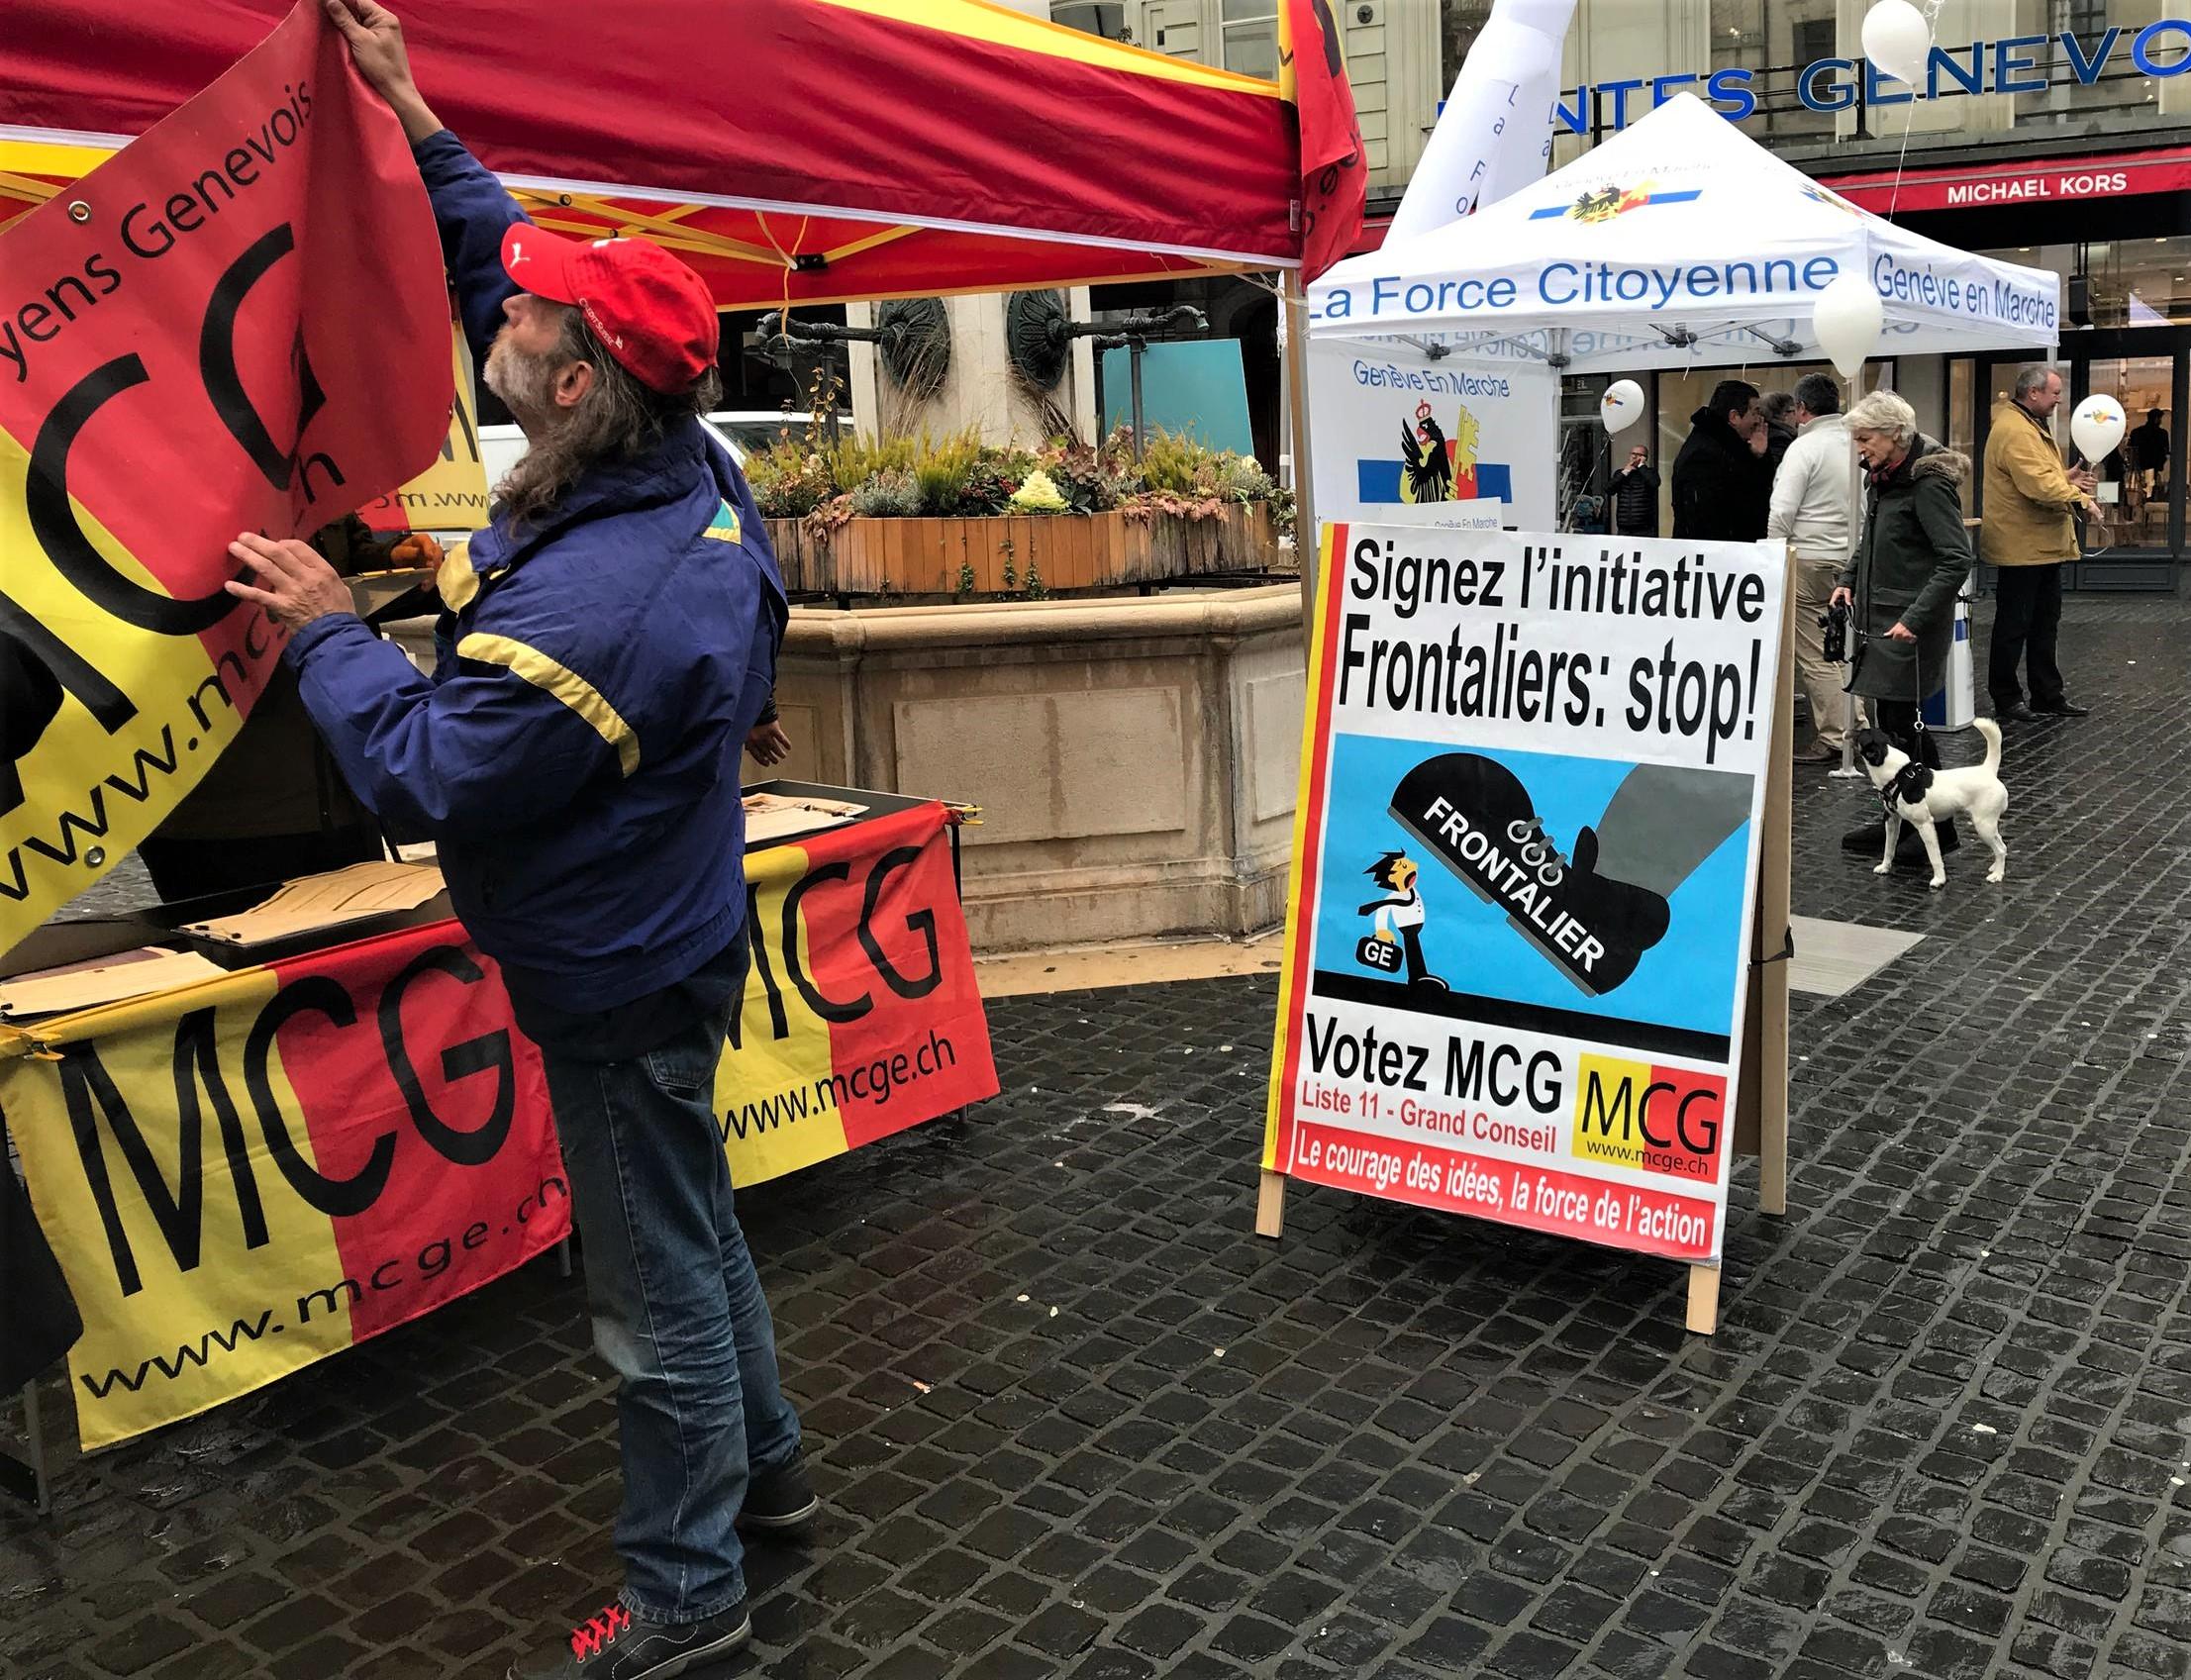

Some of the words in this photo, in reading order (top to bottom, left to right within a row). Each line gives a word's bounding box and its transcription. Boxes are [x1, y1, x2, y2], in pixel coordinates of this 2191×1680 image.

[120, 80, 312, 259] Genevois
[1947, 177, 2051, 204] MICHAEL
[2059, 172, 2128, 195] KORS
[1371, 275, 1517, 316] Force
[1539, 256, 1840, 310] Citoyenne
[1874, 252, 1959, 310] Genève
[1966, 282, 1989, 315] en
[1994, 279, 2054, 329] Marche
[1353, 359, 1424, 391] Genève
[1422, 369, 1449, 394] En
[1449, 372, 1511, 398] Marche
[1349, 538, 1506, 620] Signez
[1520, 545, 1766, 623] l’initiative
[1339, 613, 1611, 728] Frontaliers:
[1625, 638, 1762, 765] stop!
[1423, 795, 1606, 974] FRONTALIER
[1363, 940, 1393, 967] GE
[713, 1030, 956, 1144] www.mcge.ch
[1306, 1012, 1431, 1092] Votez
[1444, 1036, 1563, 1115] MCG
[58, 944, 517, 1298] MCG
[1302, 1080, 1352, 1114] Liste
[1359, 1090, 1379, 1120] 11
[1401, 1098, 1466, 1138] Grand
[1471, 1114, 1557, 1154] Conseil
[1581, 1069, 1719, 1155] MCG
[1297, 1129, 1322, 1167] Le
[1325, 1139, 1402, 1186] courage
[1407, 1150, 1442, 1192] des
[1444, 1159, 1504, 1213] idées,
[1511, 1172, 1531, 1213] la
[1532, 1177, 1586, 1226] force
[1593, 1189, 1622, 1229] de
[1626, 1193, 1707, 1247] l’action
[1586, 1139, 1709, 1176] www.mcge.ch
